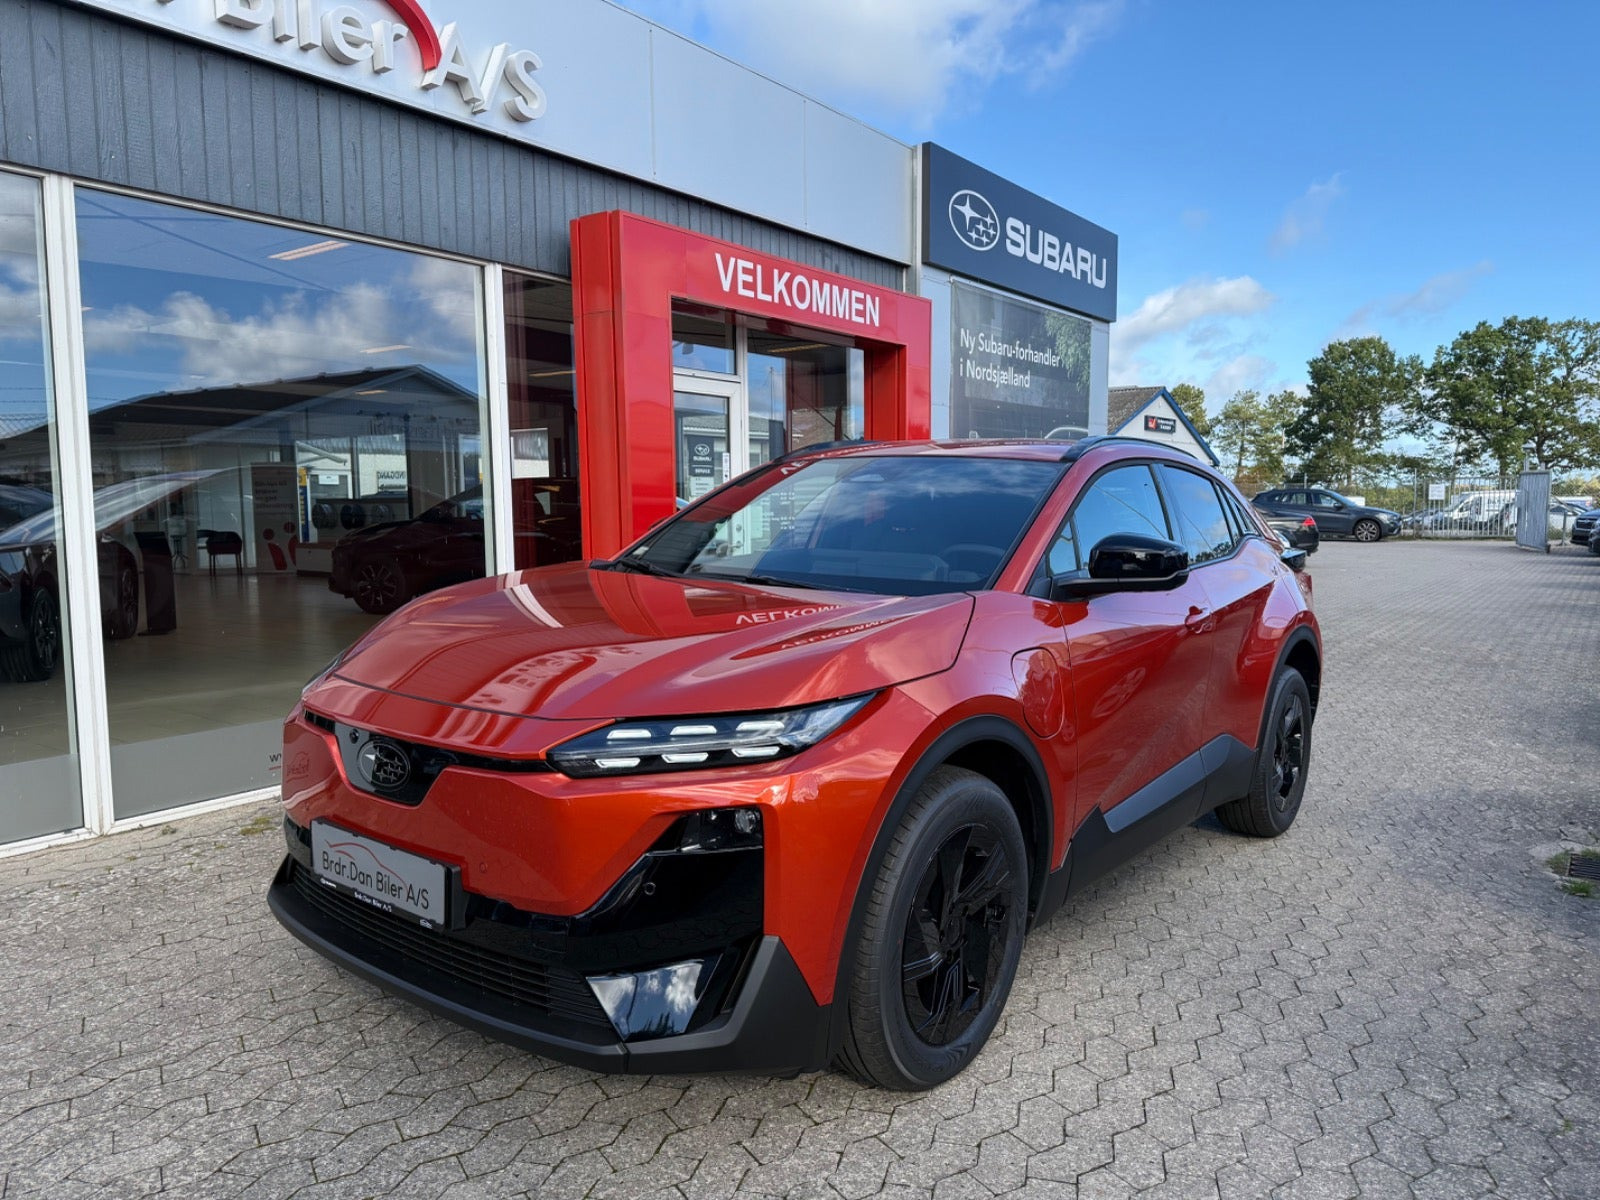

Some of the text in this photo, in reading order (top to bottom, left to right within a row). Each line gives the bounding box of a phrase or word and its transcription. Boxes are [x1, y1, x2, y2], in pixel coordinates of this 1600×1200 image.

[420, 21, 546, 122] A/S
[1005, 216, 1106, 289] SUBARU
[715, 253, 879, 327] VELKOMMEN
[960, 328, 1060, 367] Ny Subaru-forhandler
[960, 358, 1031, 388] i Nordsjælland
[376, 871, 403, 899] Biler
[406, 883, 429, 910] A/S
